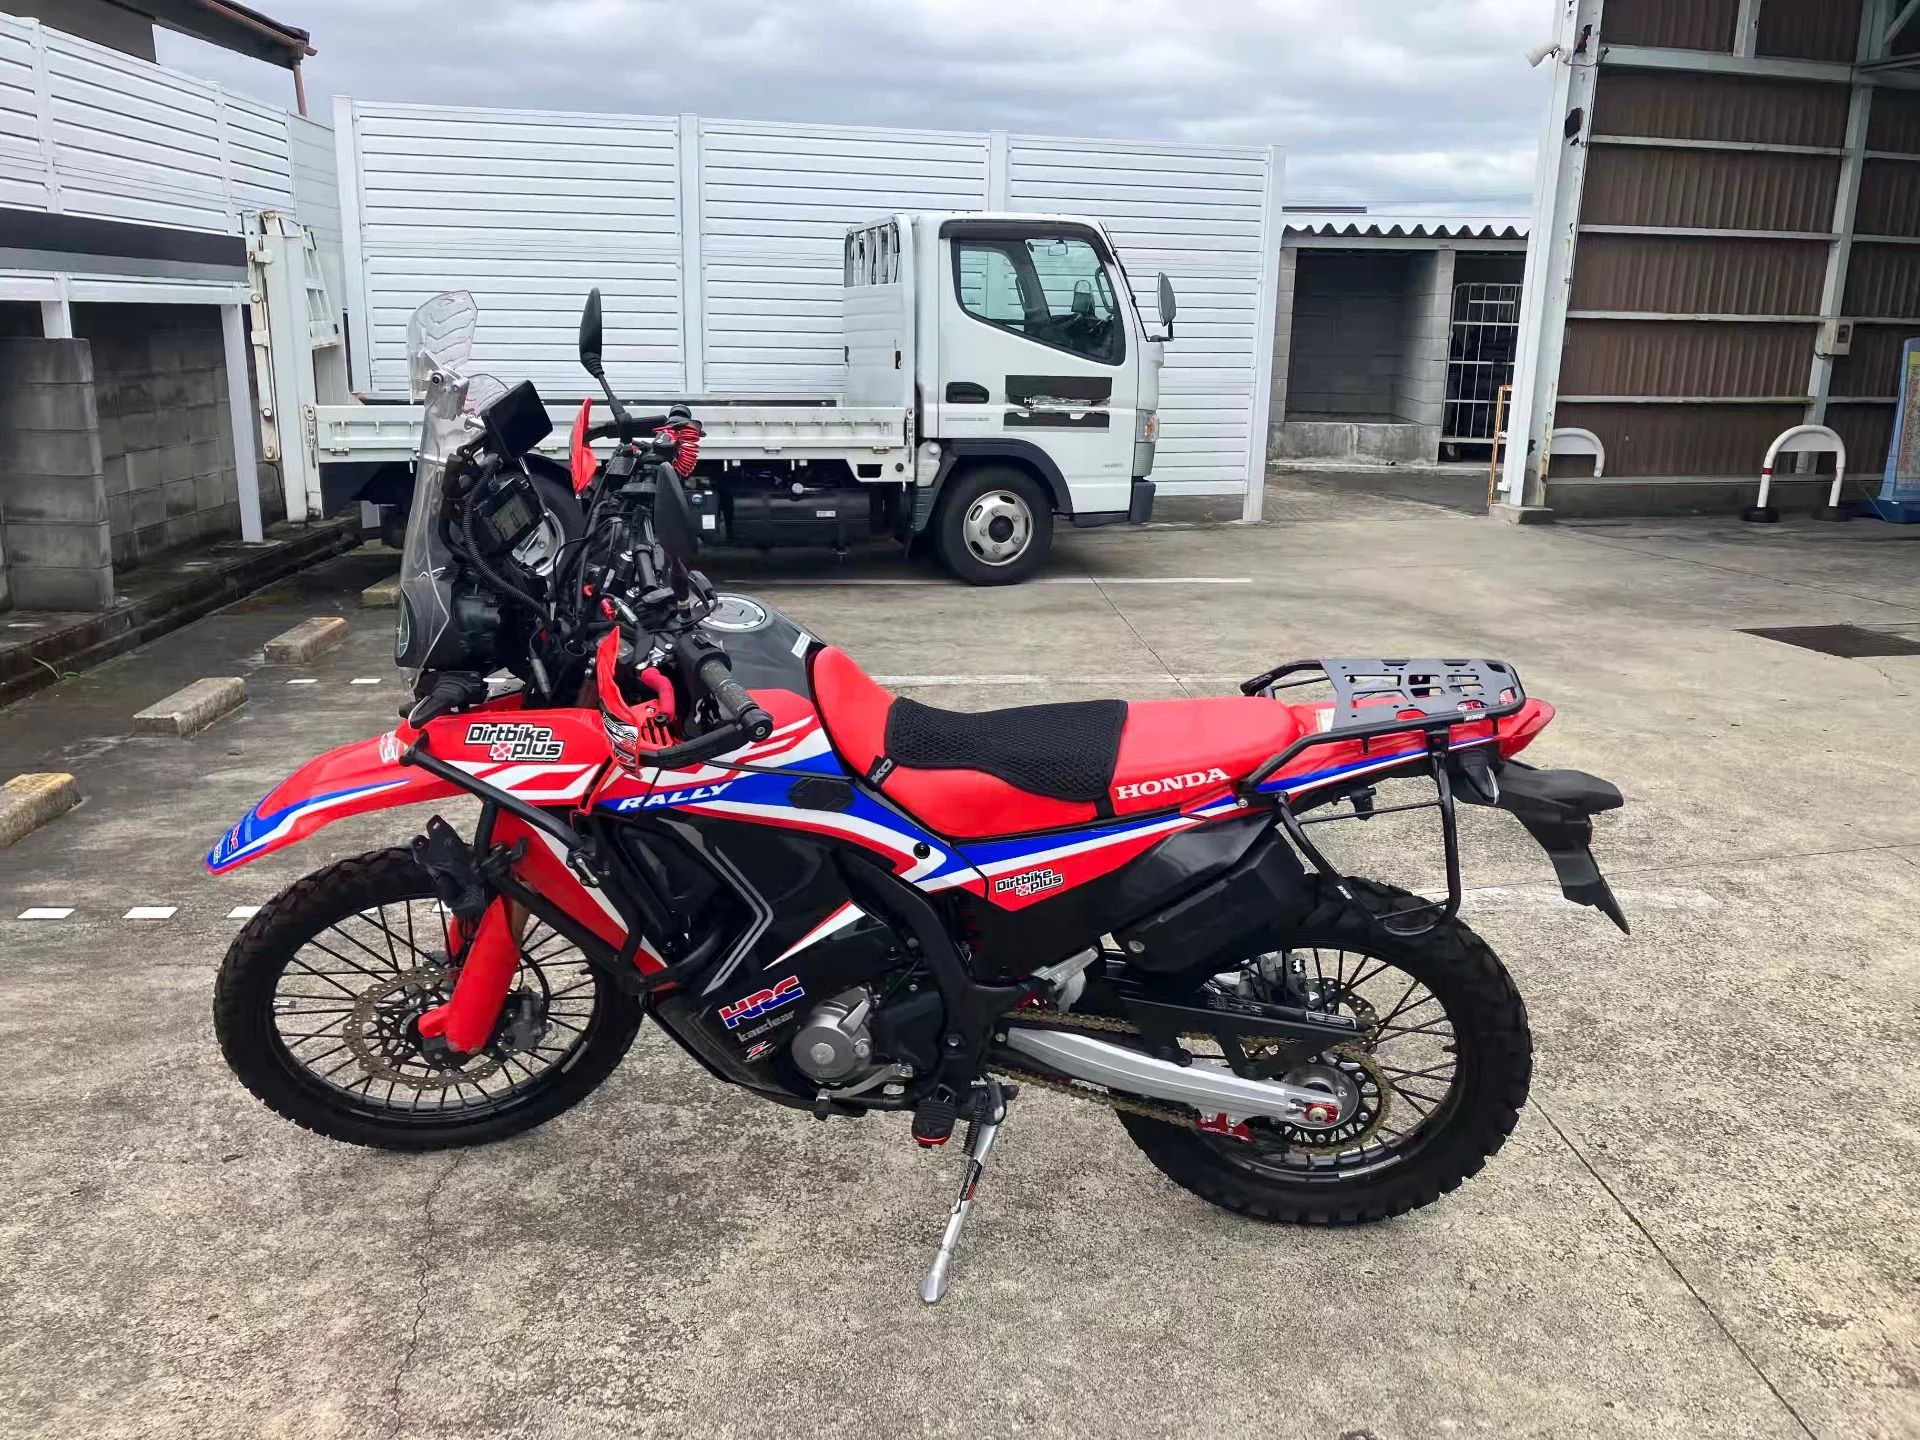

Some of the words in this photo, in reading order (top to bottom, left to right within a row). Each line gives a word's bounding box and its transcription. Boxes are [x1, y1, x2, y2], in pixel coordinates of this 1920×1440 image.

[467, 726, 550, 742] Dirtbike
[510, 742, 562, 758] plus
[1115, 767, 1231, 800] HONDA
[617, 781, 733, 811] RALLY
[996, 870, 1052, 891] Dirtbike
[1030, 875, 1062, 892] plus
[718, 975, 806, 1030] HRC
